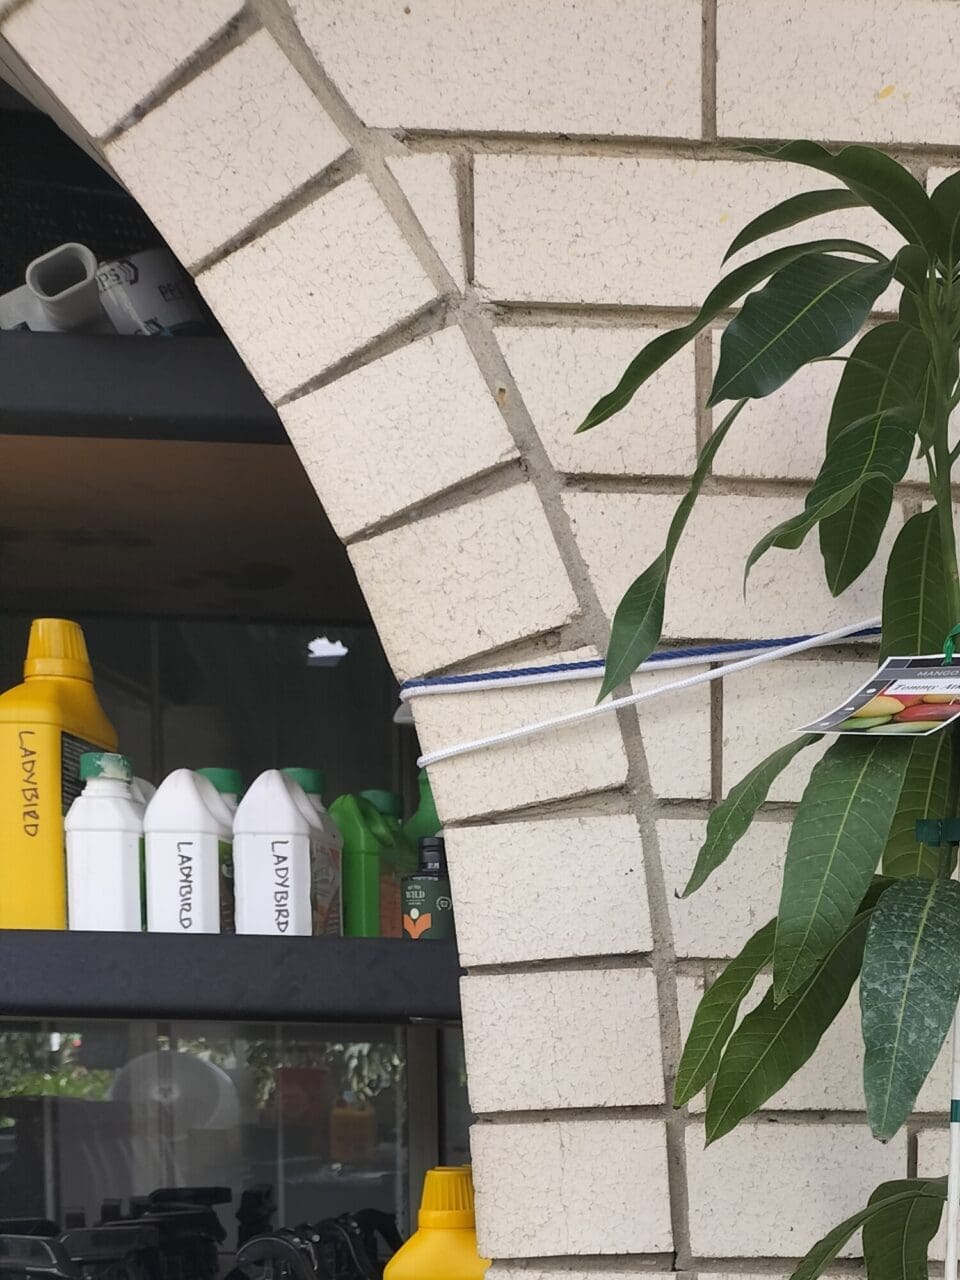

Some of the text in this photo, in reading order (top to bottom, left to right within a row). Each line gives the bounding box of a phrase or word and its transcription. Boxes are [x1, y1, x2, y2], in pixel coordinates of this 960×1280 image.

[19, 730, 39, 837] LADYBIRD
[177, 841, 193, 929] LADYBIRD
[271, 840, 290, 933] LADYBIRD
